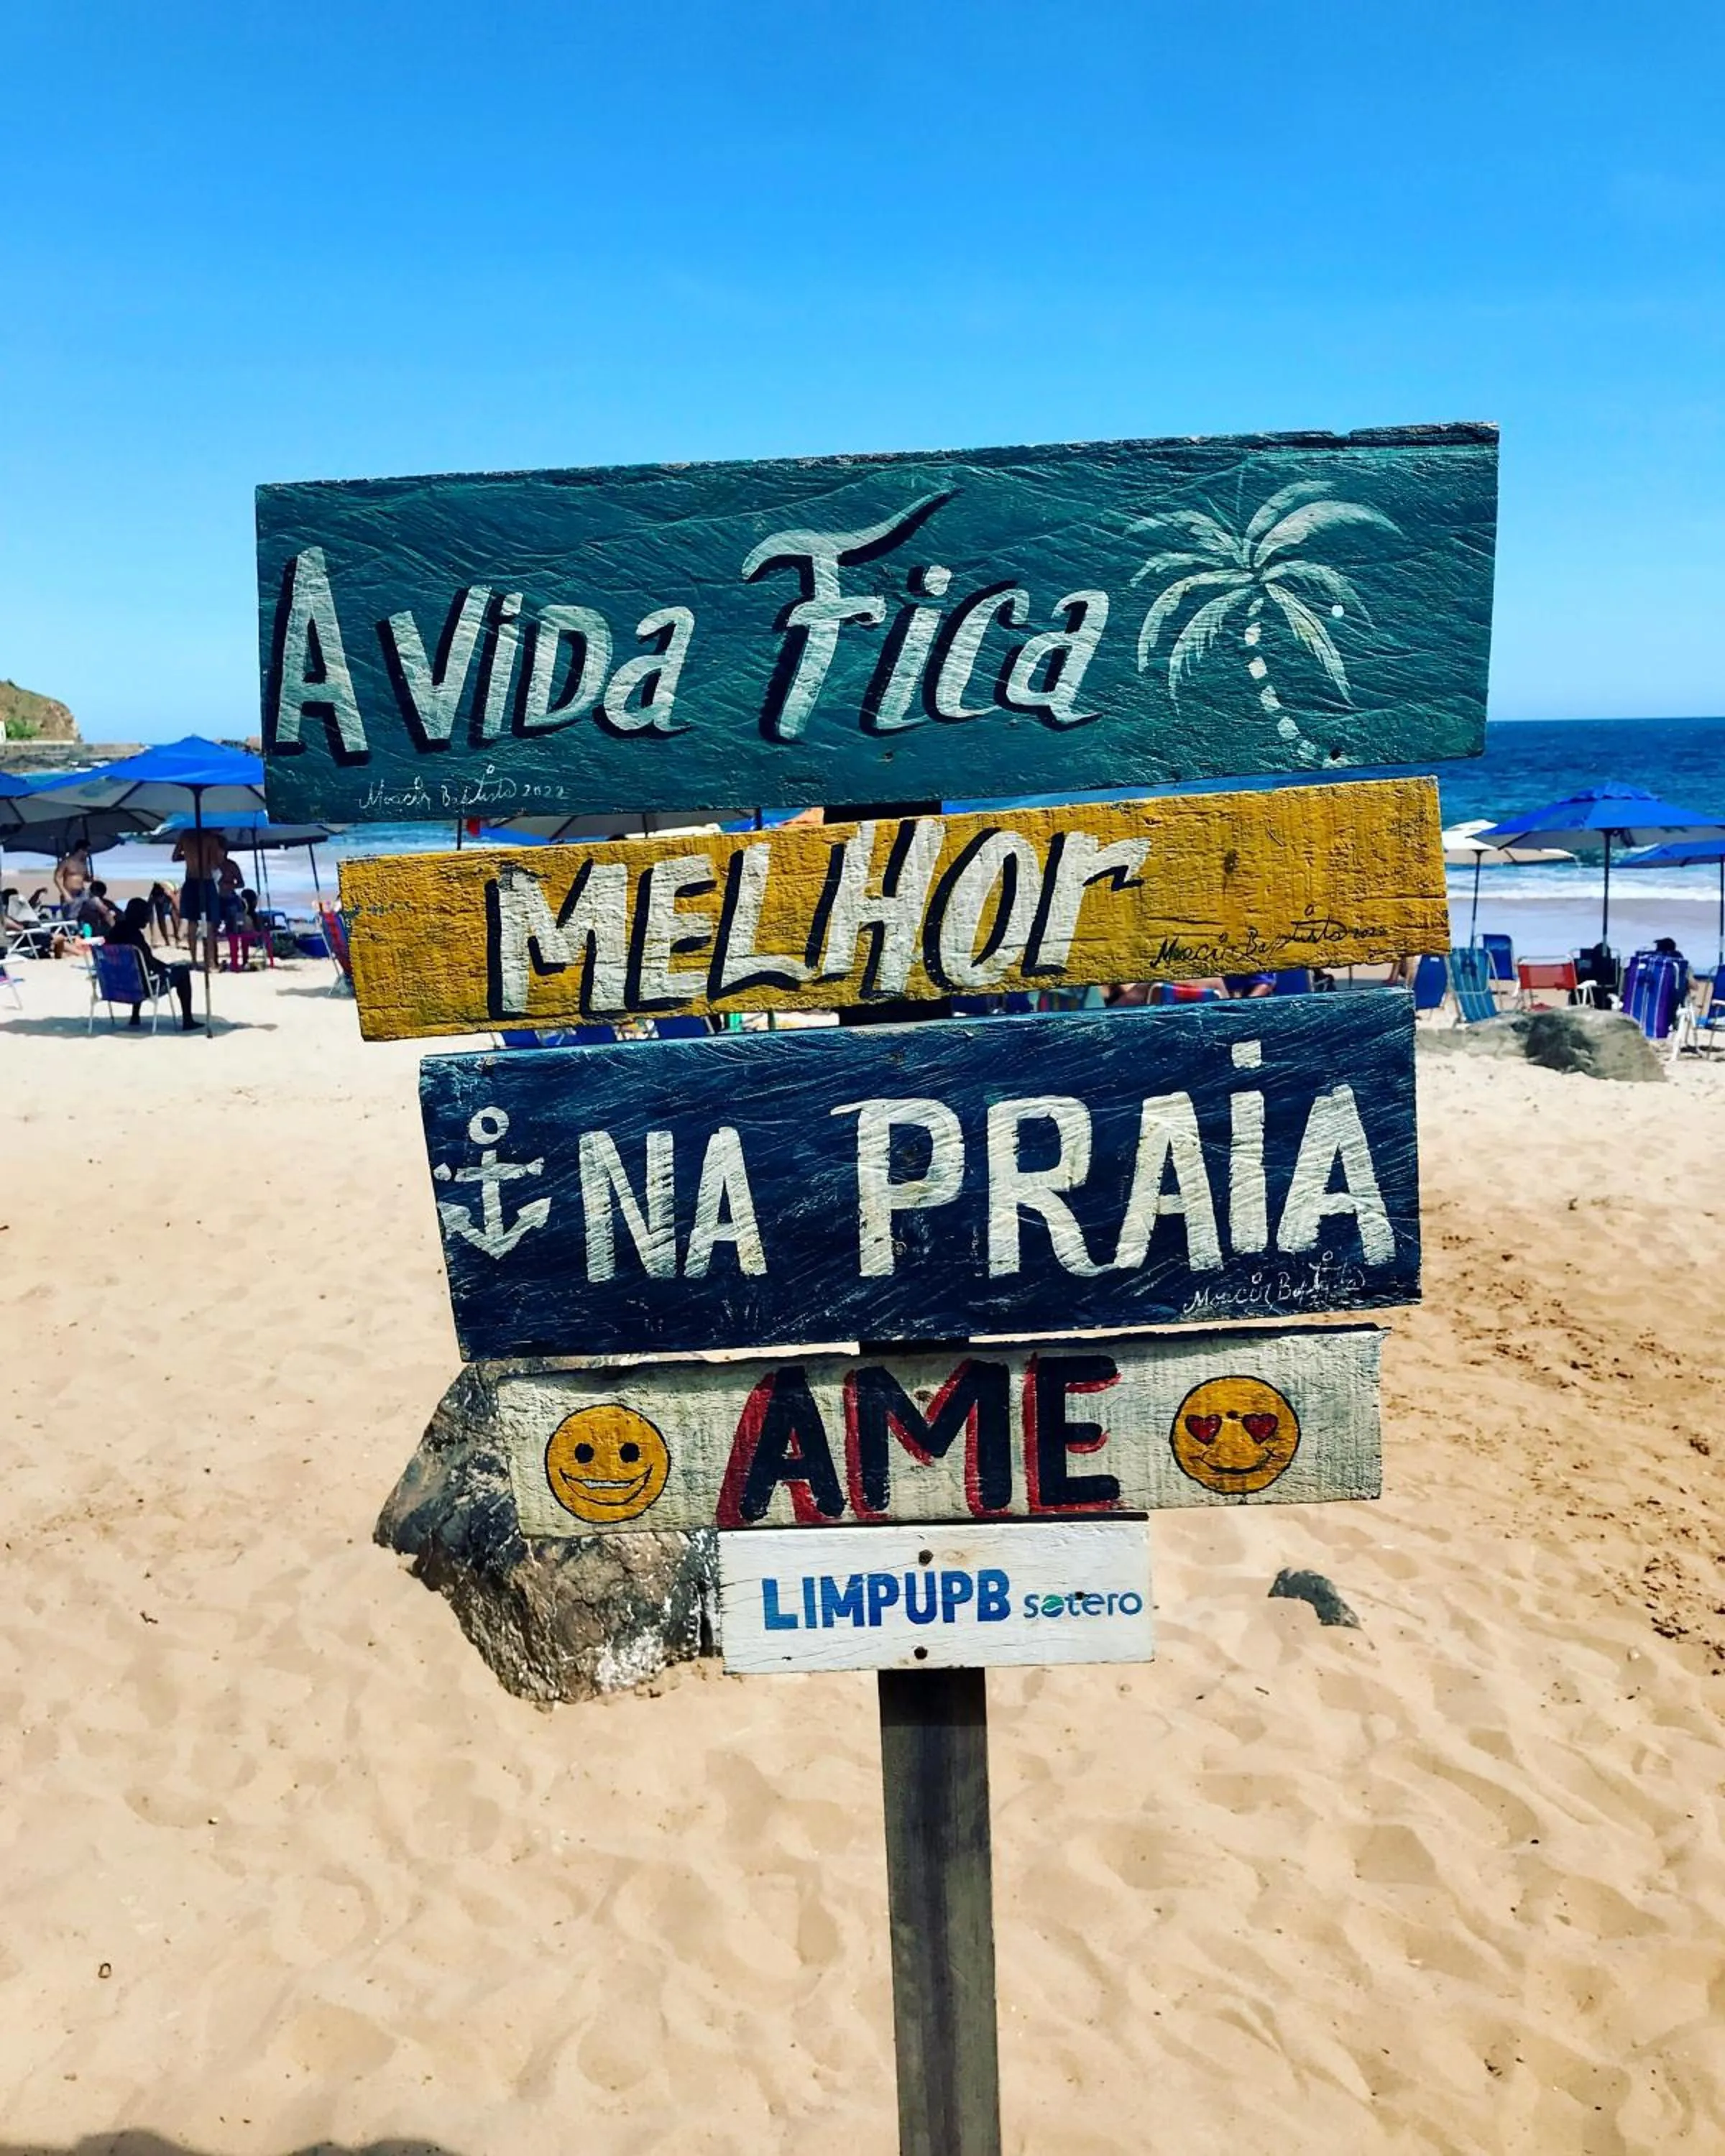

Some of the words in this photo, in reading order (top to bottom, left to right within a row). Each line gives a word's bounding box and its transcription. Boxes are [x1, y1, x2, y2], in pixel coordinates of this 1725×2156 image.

[270, 545, 369, 766] A
[578, 1126, 768, 1284] NA
[714, 1352, 1123, 1526] AME
